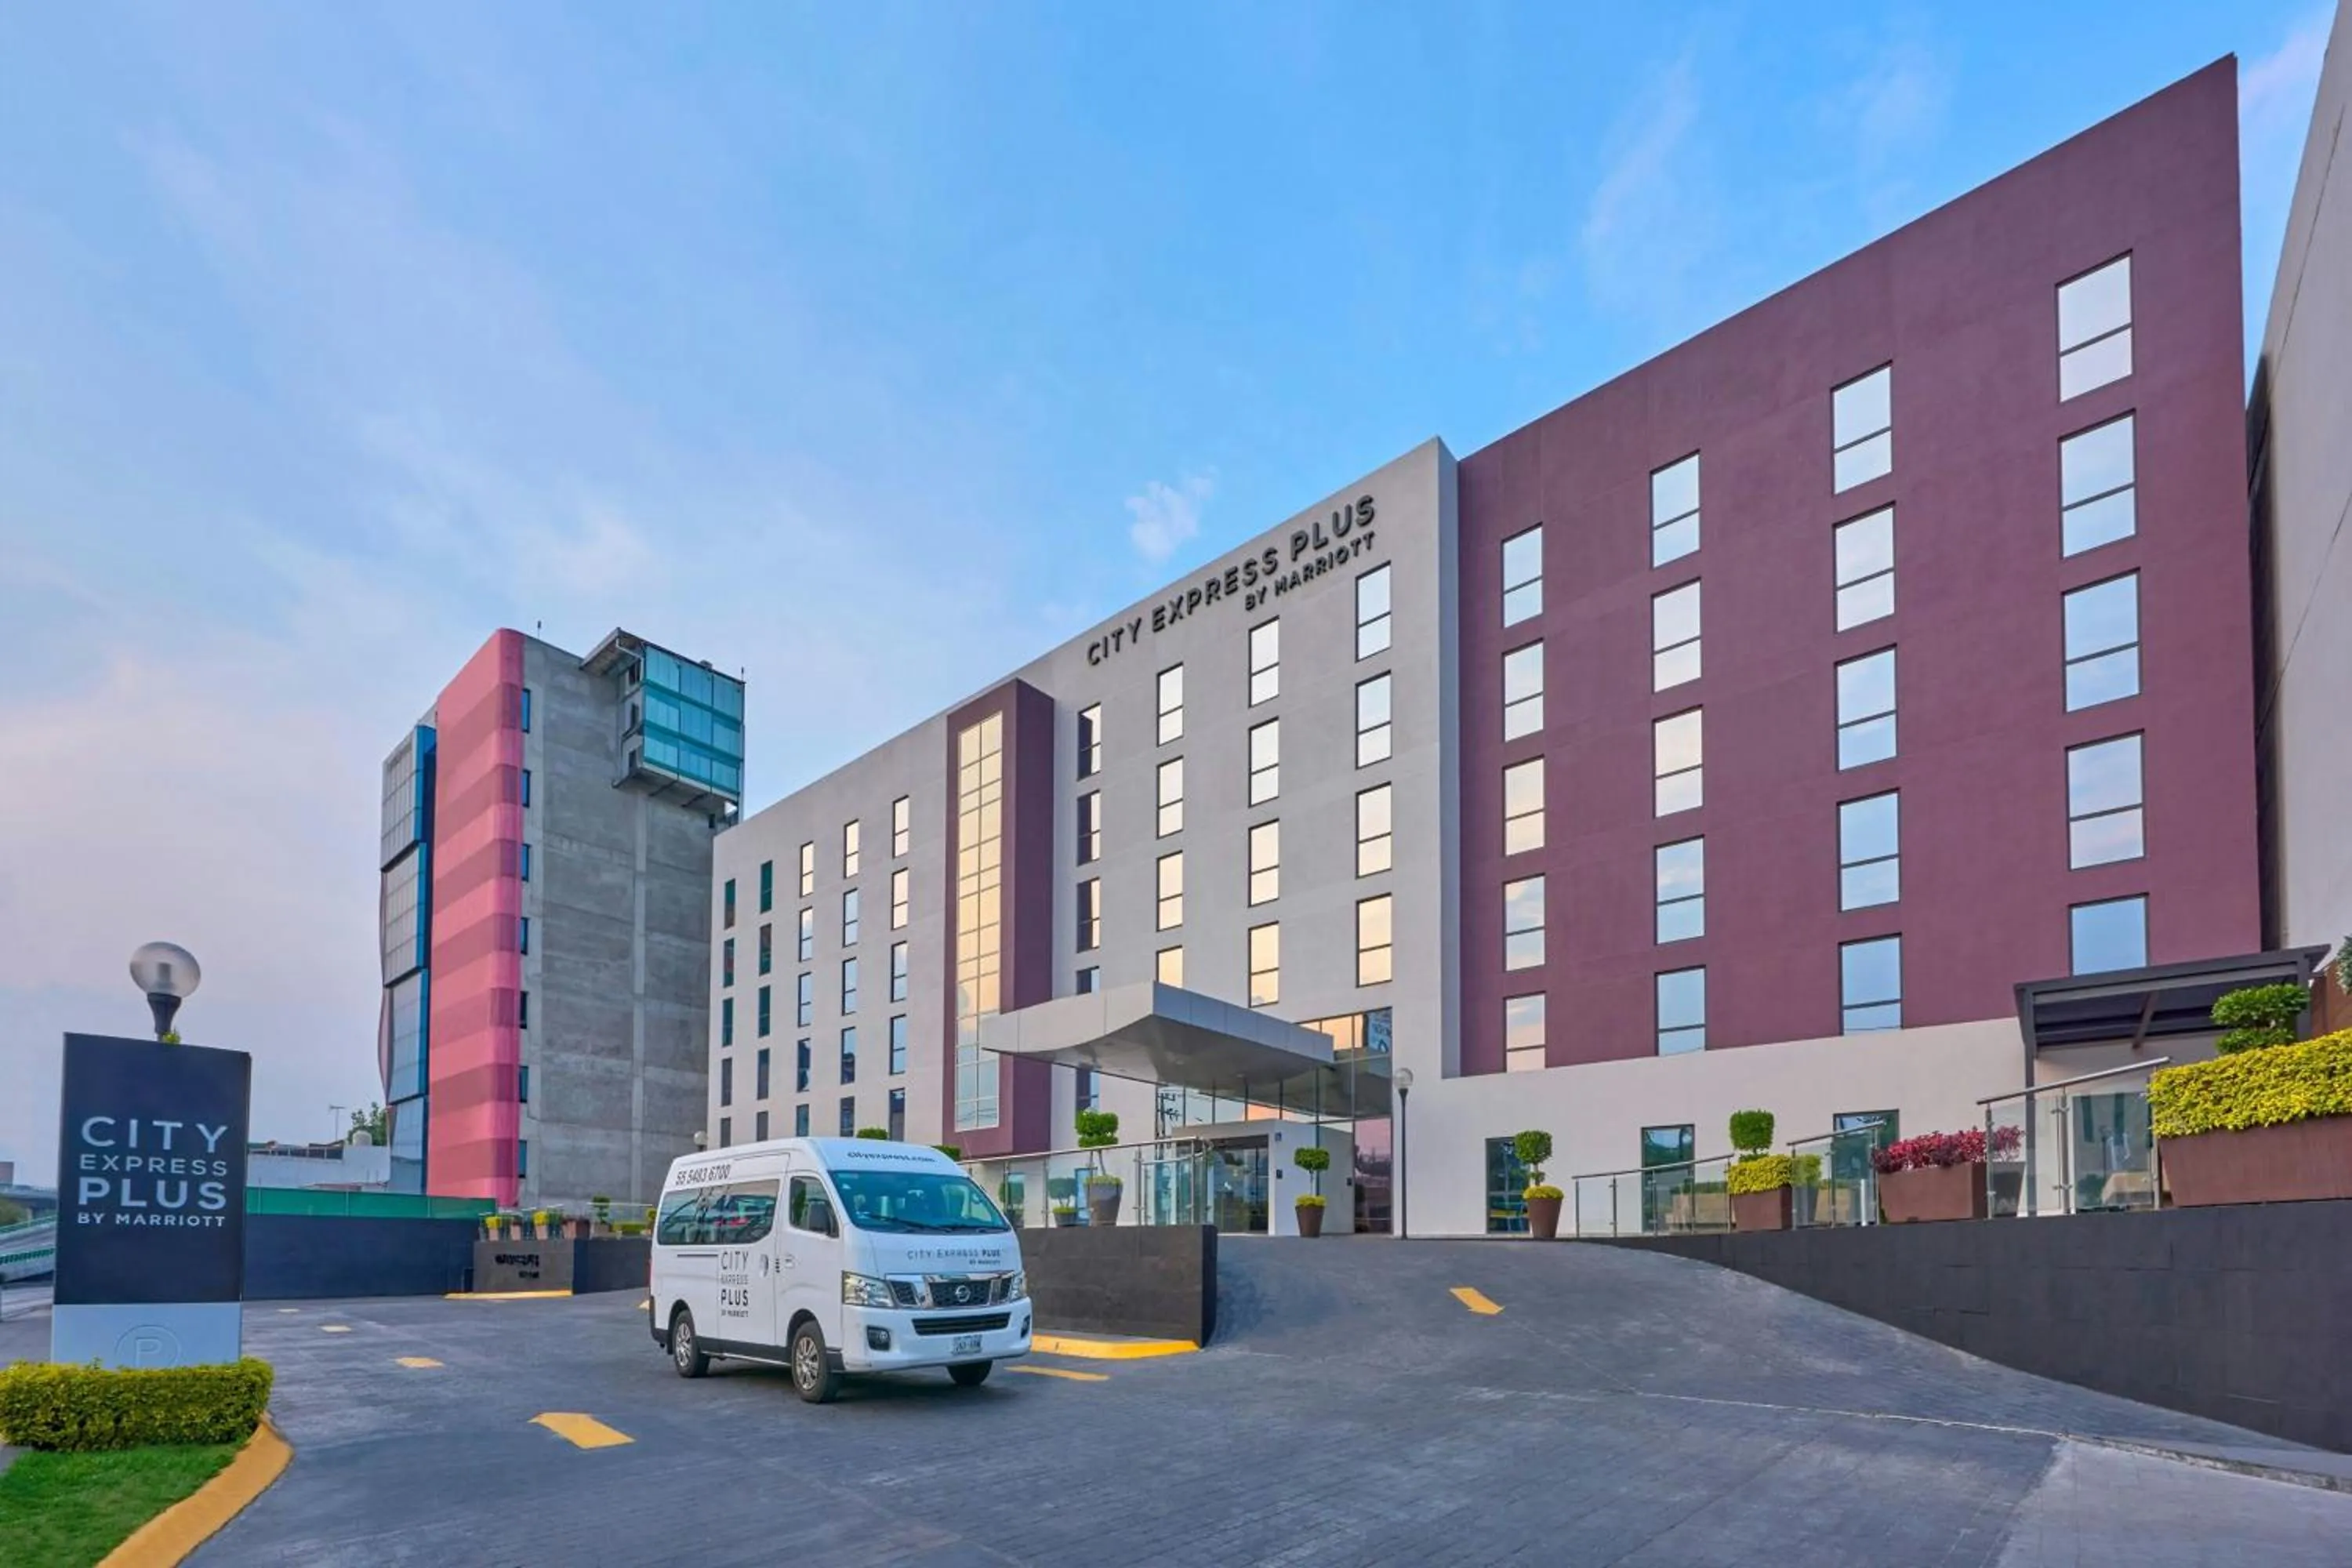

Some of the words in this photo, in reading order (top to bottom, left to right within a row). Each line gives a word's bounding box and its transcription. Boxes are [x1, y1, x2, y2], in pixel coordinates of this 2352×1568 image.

[1087, 617, 1142, 666] CITY
[1152, 546, 1278, 633] EXPRESS
[1290, 495, 1375, 562] PLUS
[1245, 586, 1267, 612] BY
[1274, 531, 1375, 597] MARRIOTT
[82, 1116, 228, 1153] CITY
[79, 1153, 227, 1176] EXPRESS
[78, 1177, 227, 1210] PLUS
[78, 1212, 105, 1225] BY
[115, 1214, 226, 1228] MARRIOTT
[721, 1250, 749, 1271] CITY
[907, 1250, 931, 1260] CITY
[721, 1289, 749, 1307] PLUS
